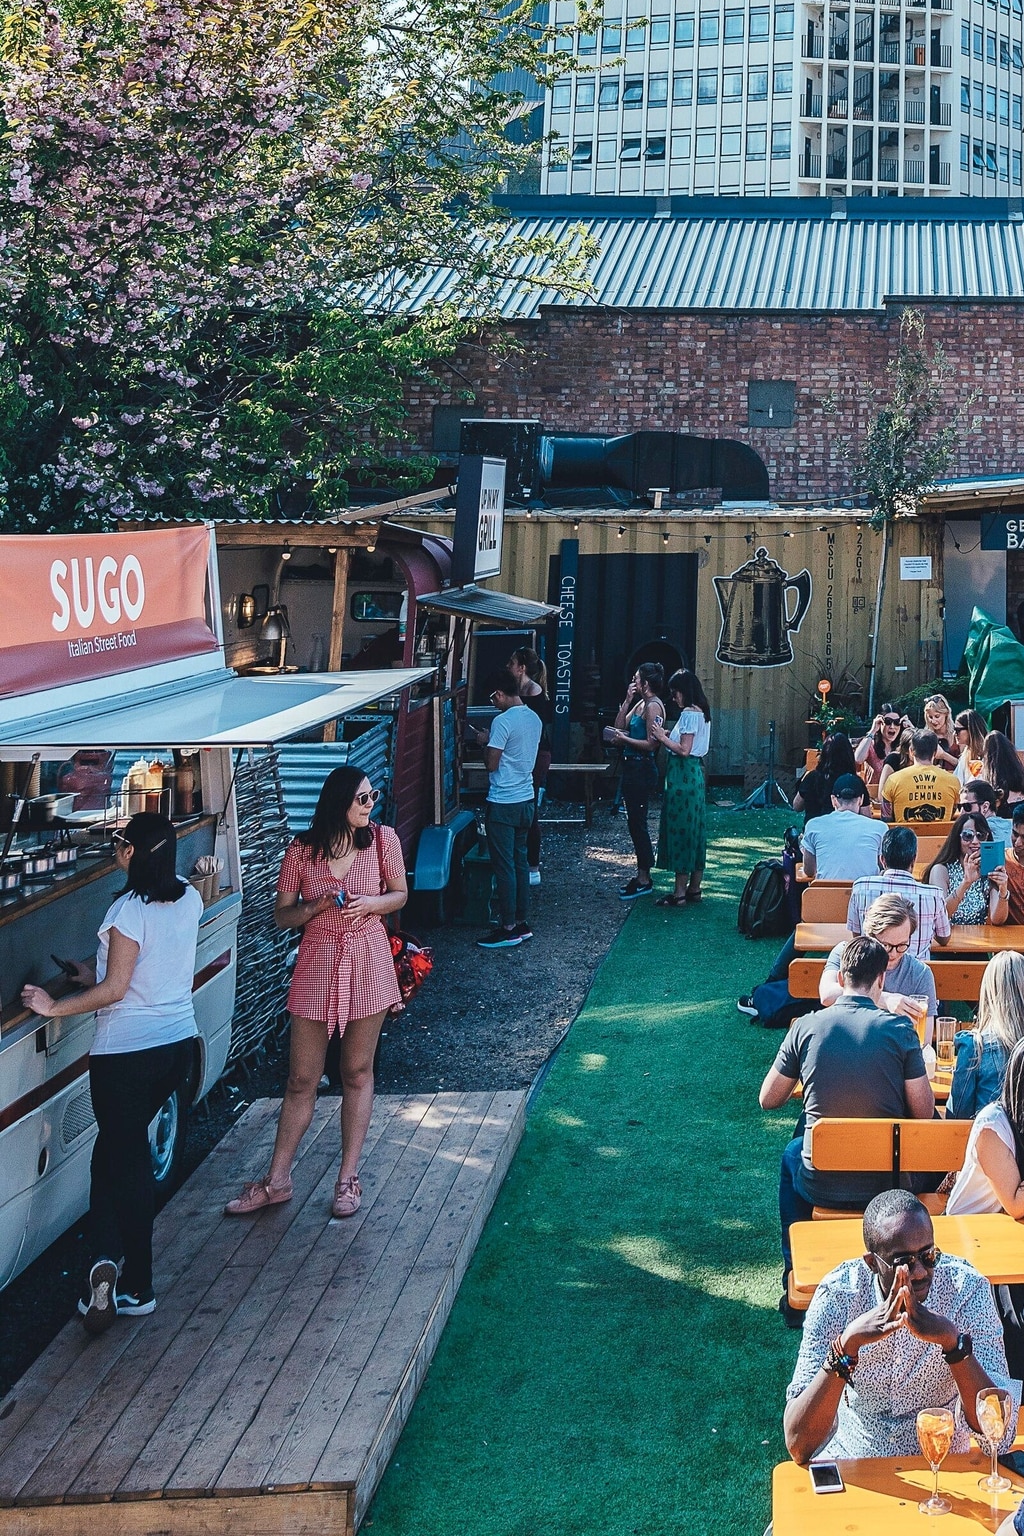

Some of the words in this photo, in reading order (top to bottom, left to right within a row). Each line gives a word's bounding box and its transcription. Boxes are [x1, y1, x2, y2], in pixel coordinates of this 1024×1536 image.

[479, 515, 496, 551] GRILL
[827, 533, 835, 580] MSCU
[50, 554, 145, 632] SUGO
[559, 575, 576, 627] CHEESE
[68, 638, 94, 658] Italian
[94, 635, 118, 653] Street
[117, 629, 137, 648] Food
[555, 641, 572, 714] TOASTIES
[909, 792, 942, 801] DEMONS
[913, 774, 937, 783] DOWN
